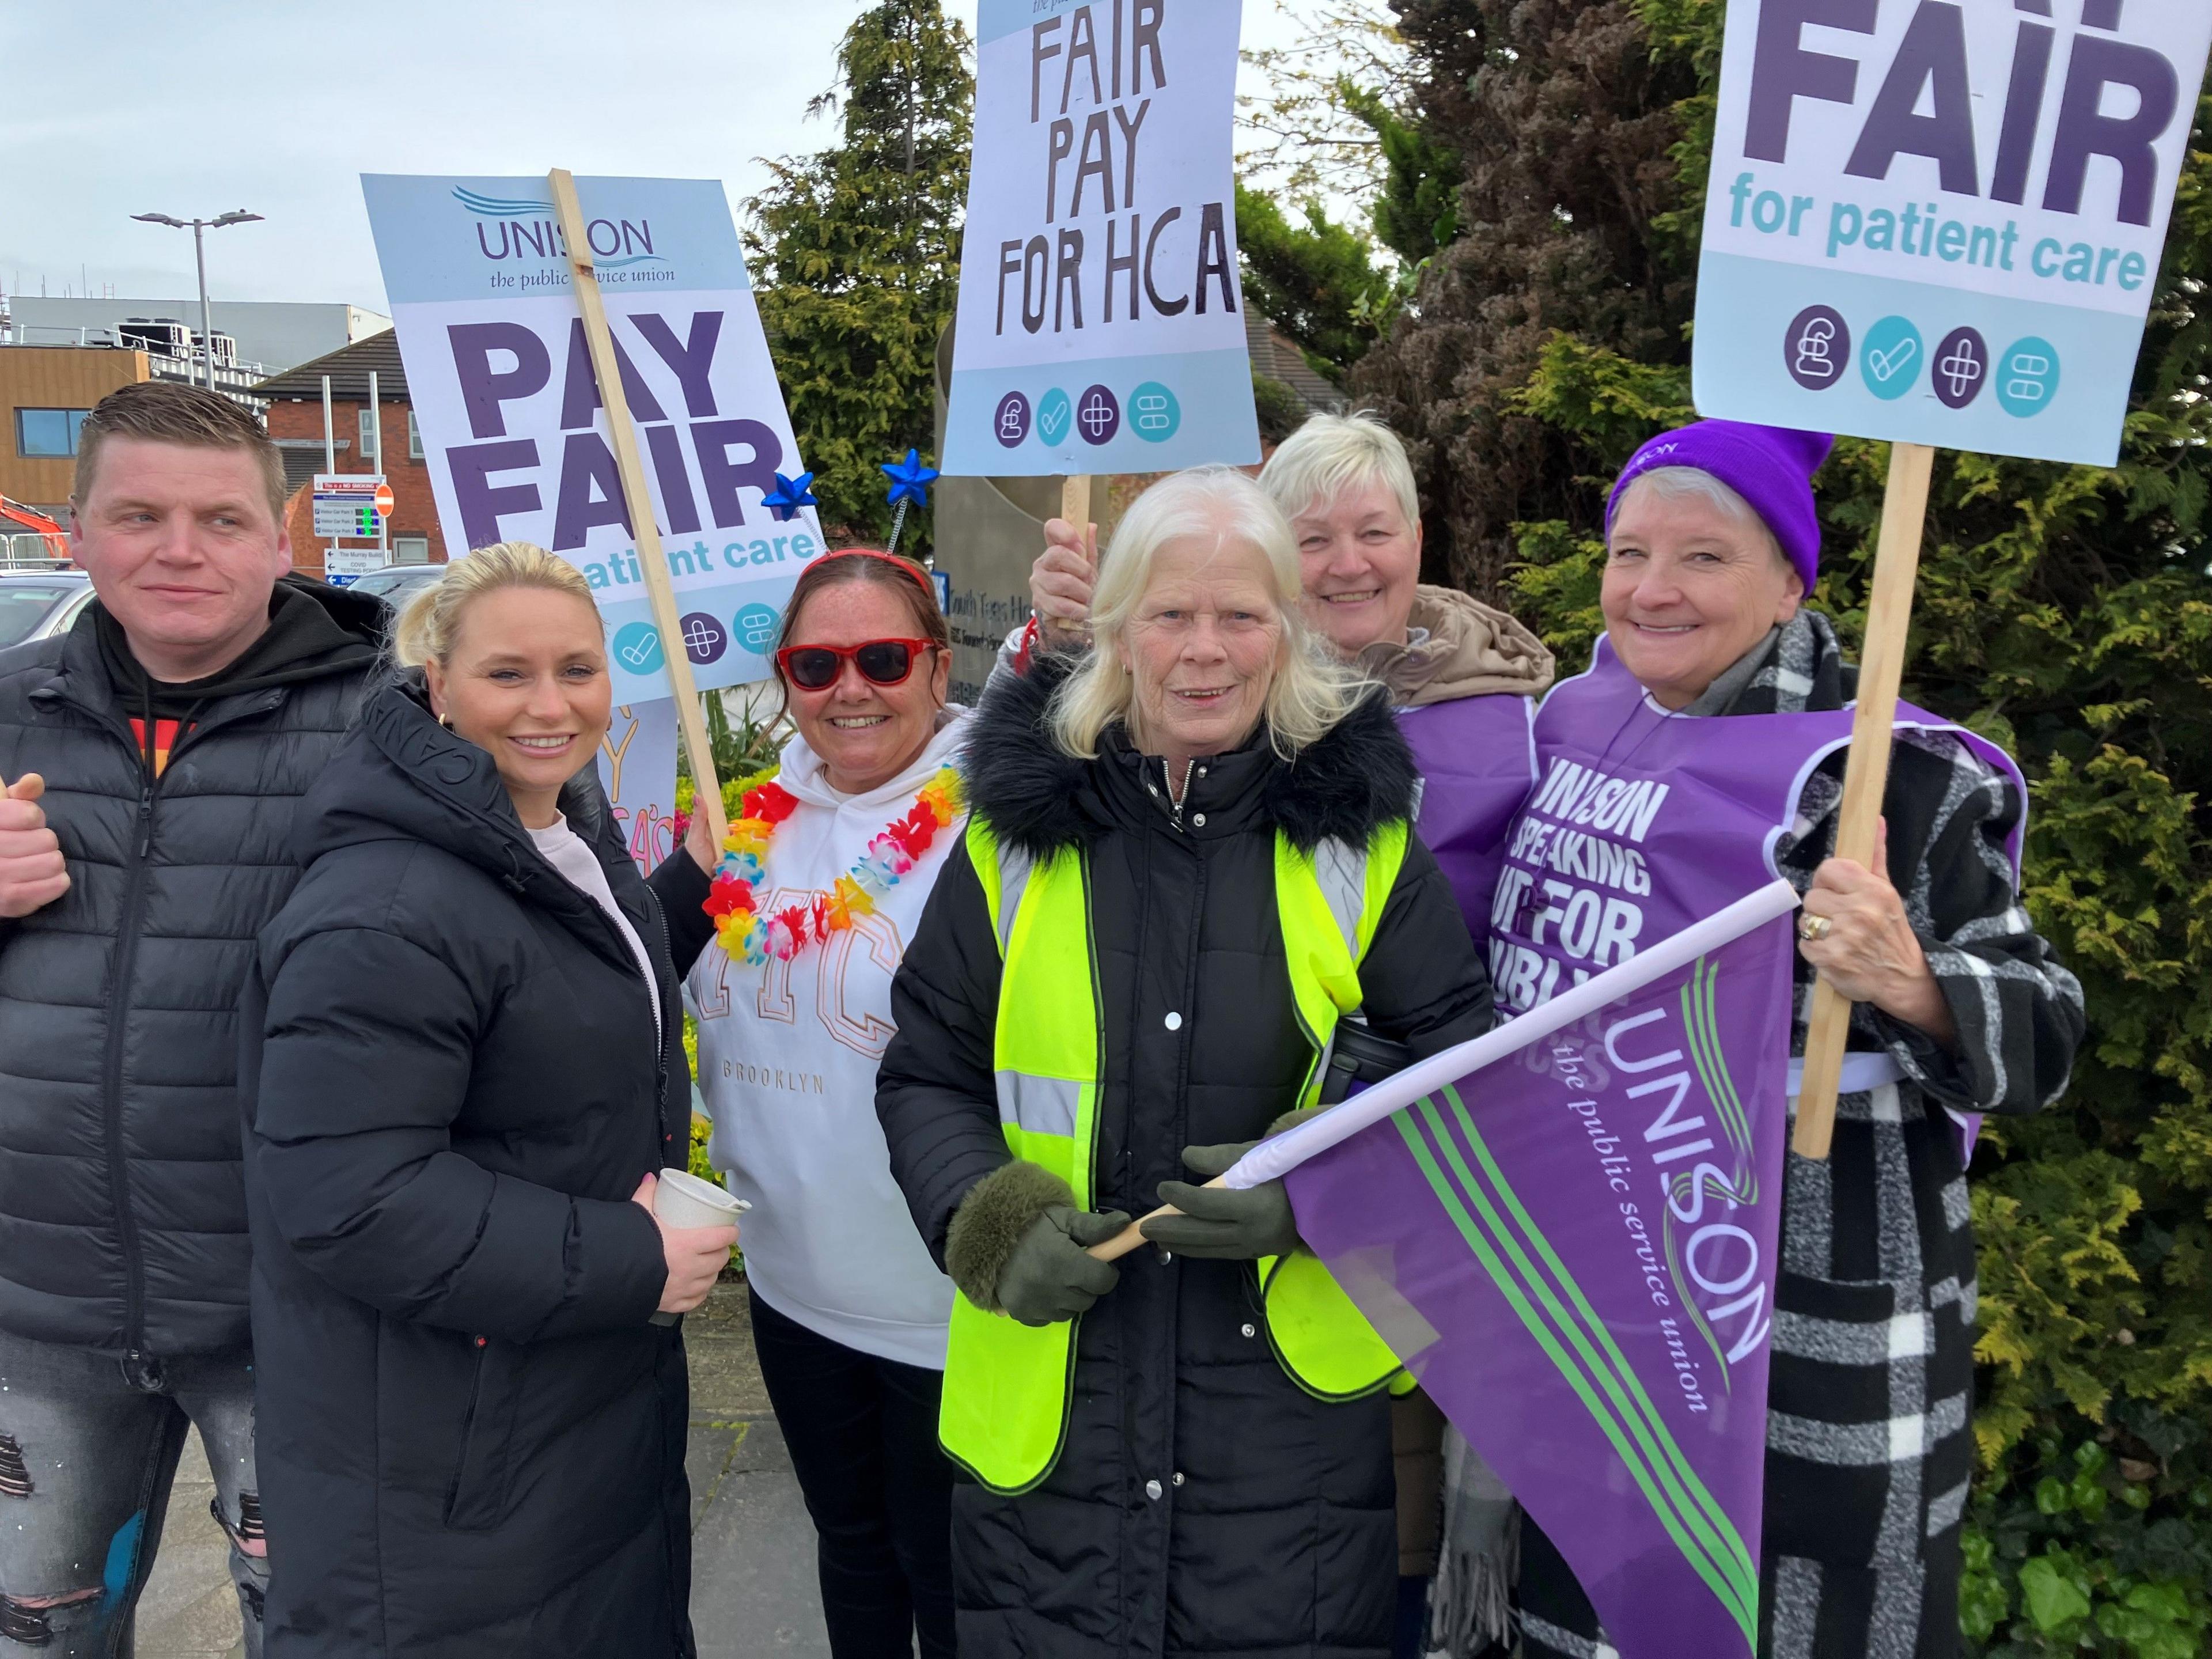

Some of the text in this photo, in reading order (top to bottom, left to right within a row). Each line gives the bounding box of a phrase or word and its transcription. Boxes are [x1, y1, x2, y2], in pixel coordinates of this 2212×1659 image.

[1031, 0, 1166, 123] FAIR
[1743, 0, 2179, 227] FAIR
[1046, 99, 1151, 224] PAY
[491, 269, 675, 290] the public vice union
[996, 202, 1236, 336] FOR HCA
[1729, 172, 2146, 291] for patient care
[447, 312, 724, 439] PAY
[445, 418, 800, 552] FAIR
[584, 534, 814, 589] atint care
[1510, 816, 1651, 896] SPEAKING
[1532, 878, 1643, 968] FOR
[723, 1060, 824, 1094] BROOKLYN
[1552, 1043, 1708, 1415] the public service union
[1604, 1007, 1770, 1365] UNISON
